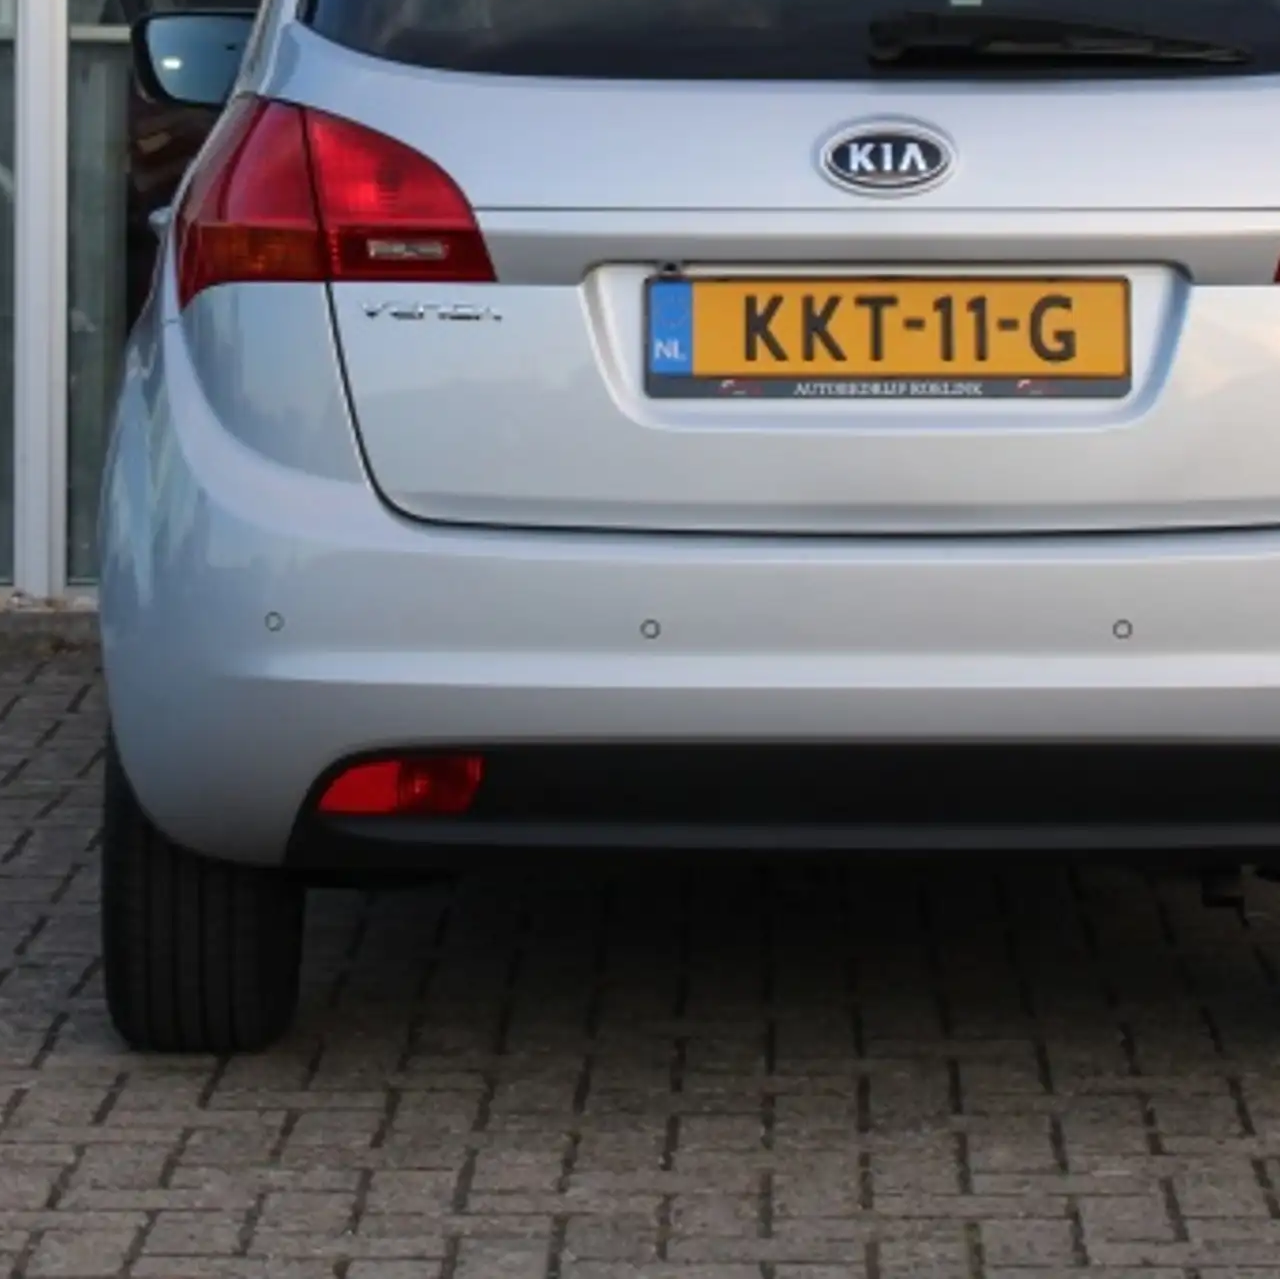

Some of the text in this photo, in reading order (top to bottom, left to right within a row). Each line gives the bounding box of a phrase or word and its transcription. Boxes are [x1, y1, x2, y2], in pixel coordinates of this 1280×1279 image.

[848, 142, 927, 172] KIA
[743, 295, 1077, 363] KKT-11-G
[653, 337, 688, 362] NL
